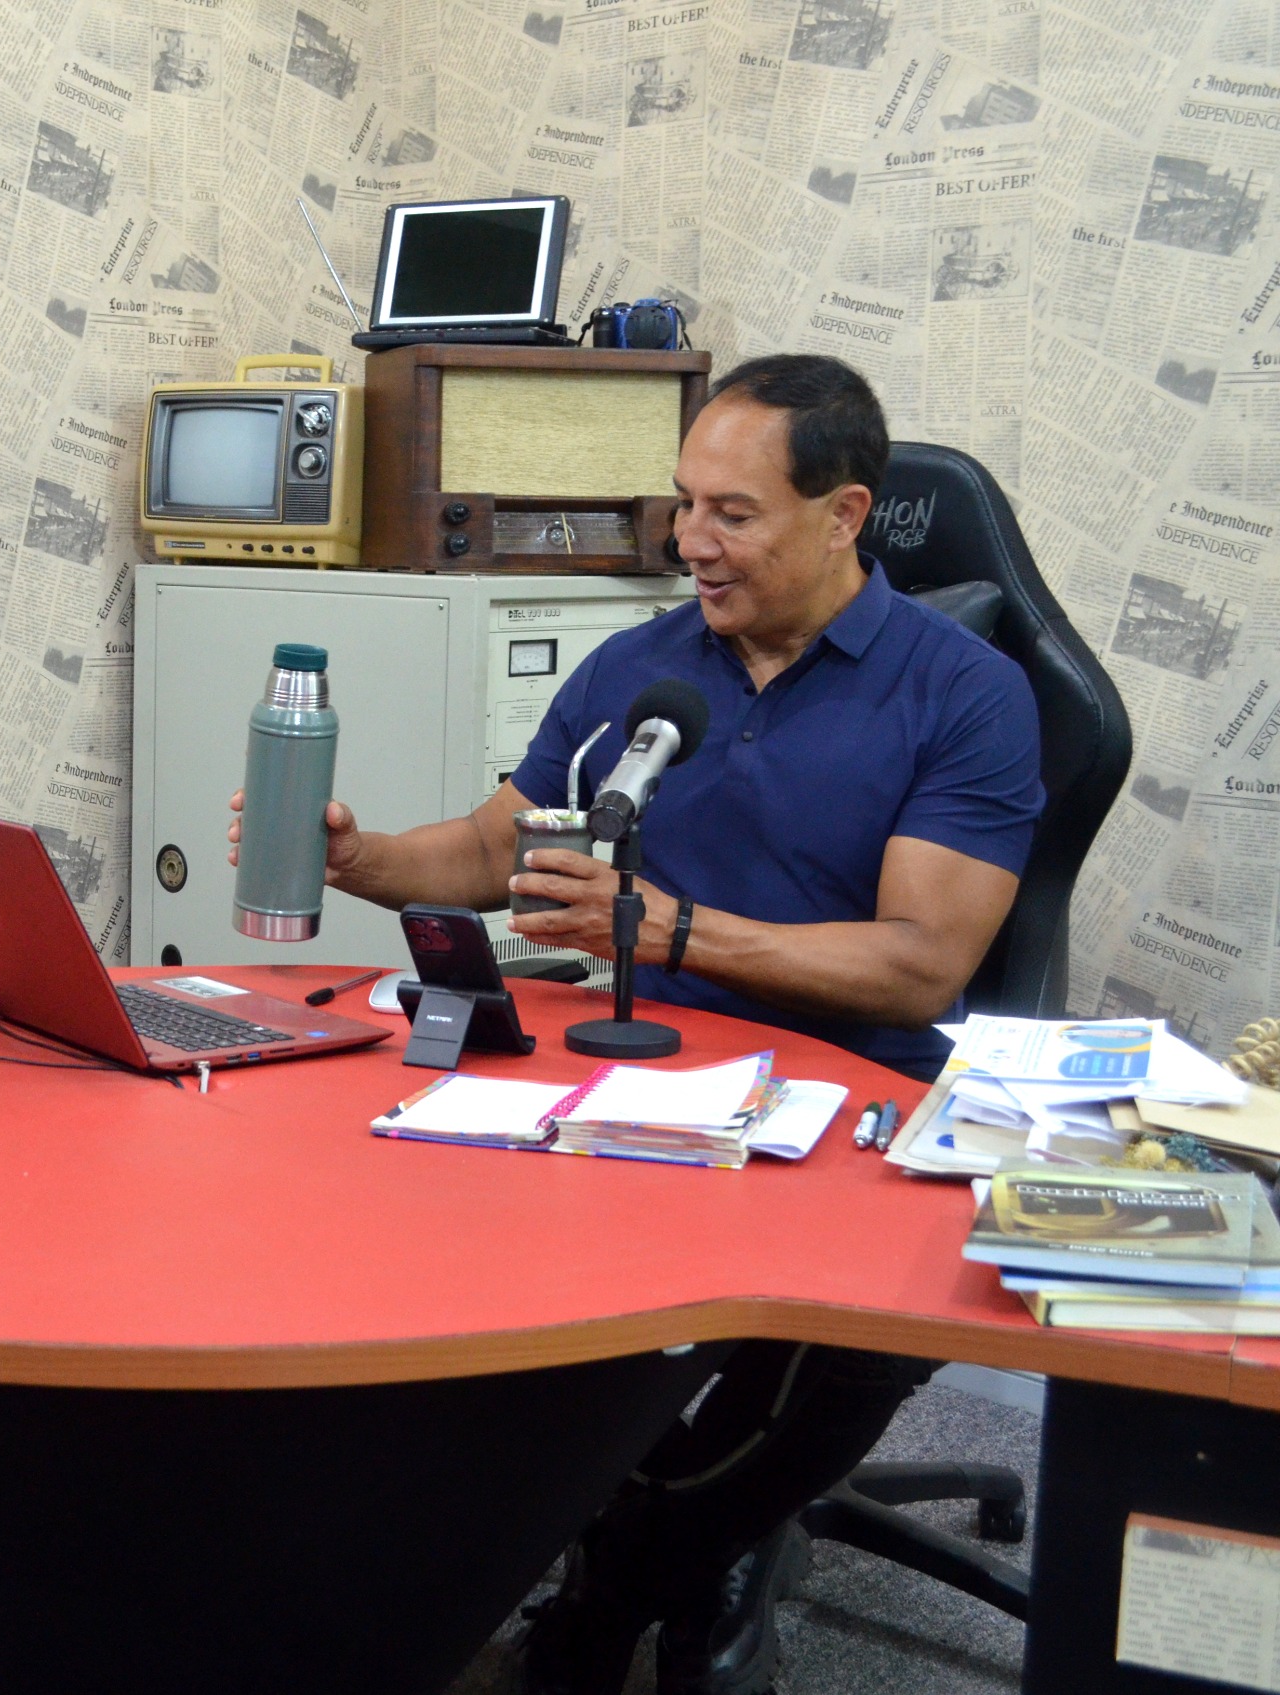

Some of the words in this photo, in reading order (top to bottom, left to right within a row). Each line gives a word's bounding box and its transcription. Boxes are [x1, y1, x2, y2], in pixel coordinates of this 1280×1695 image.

[627, 17, 661, 33] BEST
[248, 53, 263, 67] the
[739, 52, 757, 67] the
[72, 62, 132, 101] Independence
[903, 52, 951, 135] RESOURCES
[541, 124, 604, 147] Independence
[884, 150, 935, 171] London
[935, 179, 974, 197] BEST
[1072, 227, 1096, 246] the
[123, 218, 158, 285] RESOURCES
[109, 297, 147, 315] London
[829, 291, 904, 321] Independence
[148, 331, 176, 346] BEST
[67, 417, 128, 449] Independence
[873, 488, 937, 535] HON
[1181, 501, 1273, 539] Independence
[888, 528, 926, 552] RGB
[1218, 679, 1269, 750] Enterprise
[63, 762, 123, 787] Independence
[1154, 911, 1242, 959] Independence
